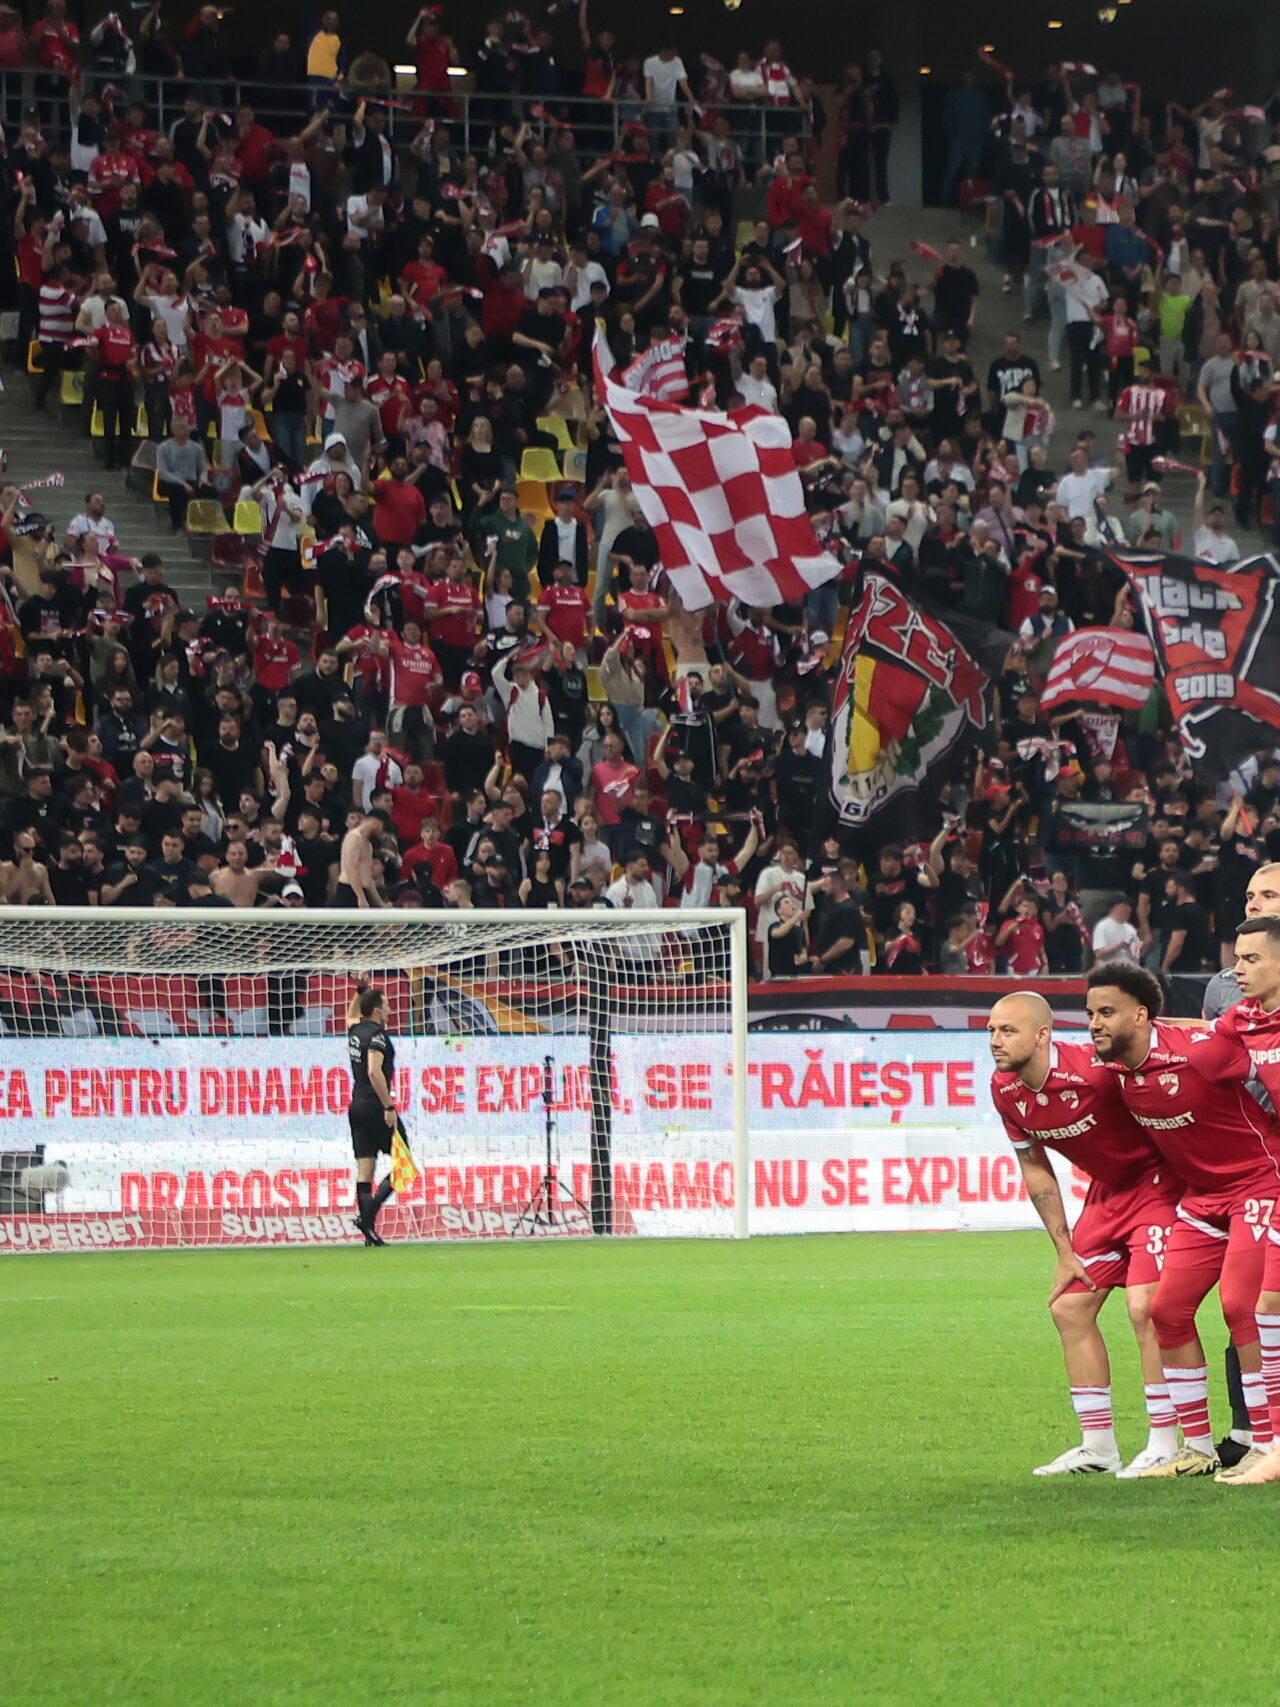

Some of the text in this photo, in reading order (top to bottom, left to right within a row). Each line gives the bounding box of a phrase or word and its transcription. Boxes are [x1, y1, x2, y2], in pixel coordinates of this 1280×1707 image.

[1174, 673, 1235, 702] 2019
[45, 1066, 188, 1117] PENTRU
[200, 1065, 350, 1116] DINAMO
[420, 1064, 465, 1113] SE
[476, 1052, 632, 1115] EXPLIC,
[645, 1062, 712, 1110] SE
[120, 1167, 377, 1213] DRAGOSTE
[572, 1160, 735, 1210] DNAMO
[755, 1160, 808, 1208] NU
[821, 1160, 869, 1206] SE
[221, 1212, 358, 1240] SUPERBE
[1243, 1198, 1275, 1226] 27
